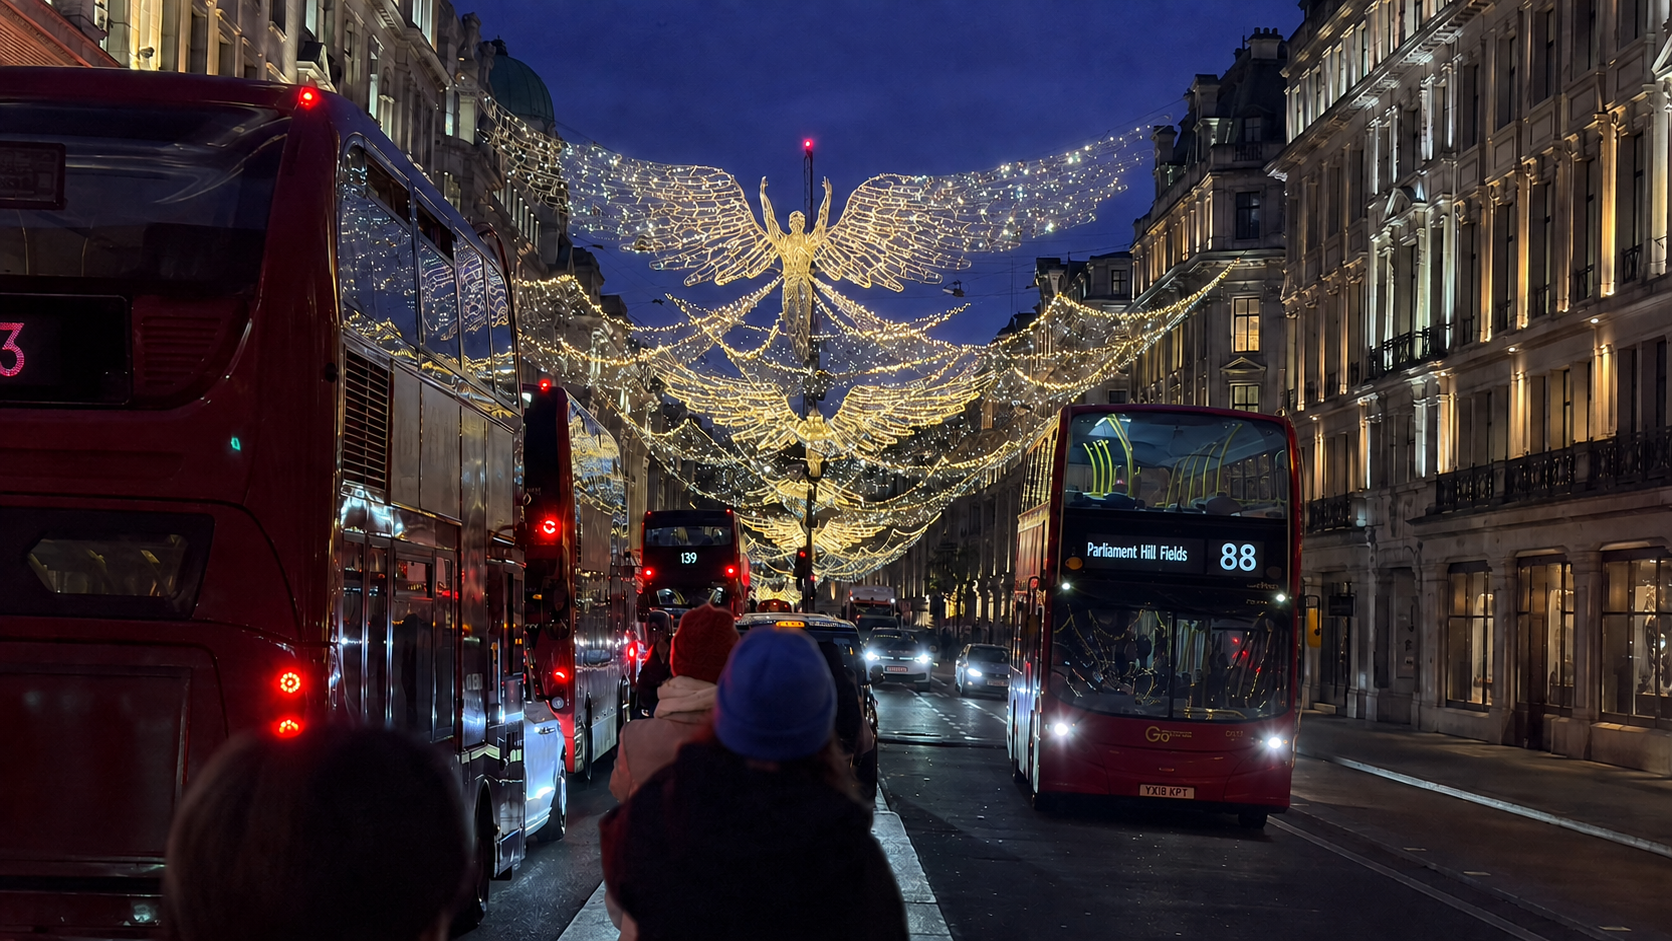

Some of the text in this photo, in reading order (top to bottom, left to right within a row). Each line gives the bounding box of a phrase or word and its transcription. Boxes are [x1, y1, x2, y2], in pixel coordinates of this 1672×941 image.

[681, 552, 697, 564] 139
[1087, 541, 1188, 562] Parliament Hill Fields
[1220, 542, 1257, 572] 88
[1145, 725, 1171, 743] Go
[1169, 787, 1188, 797] KPT
